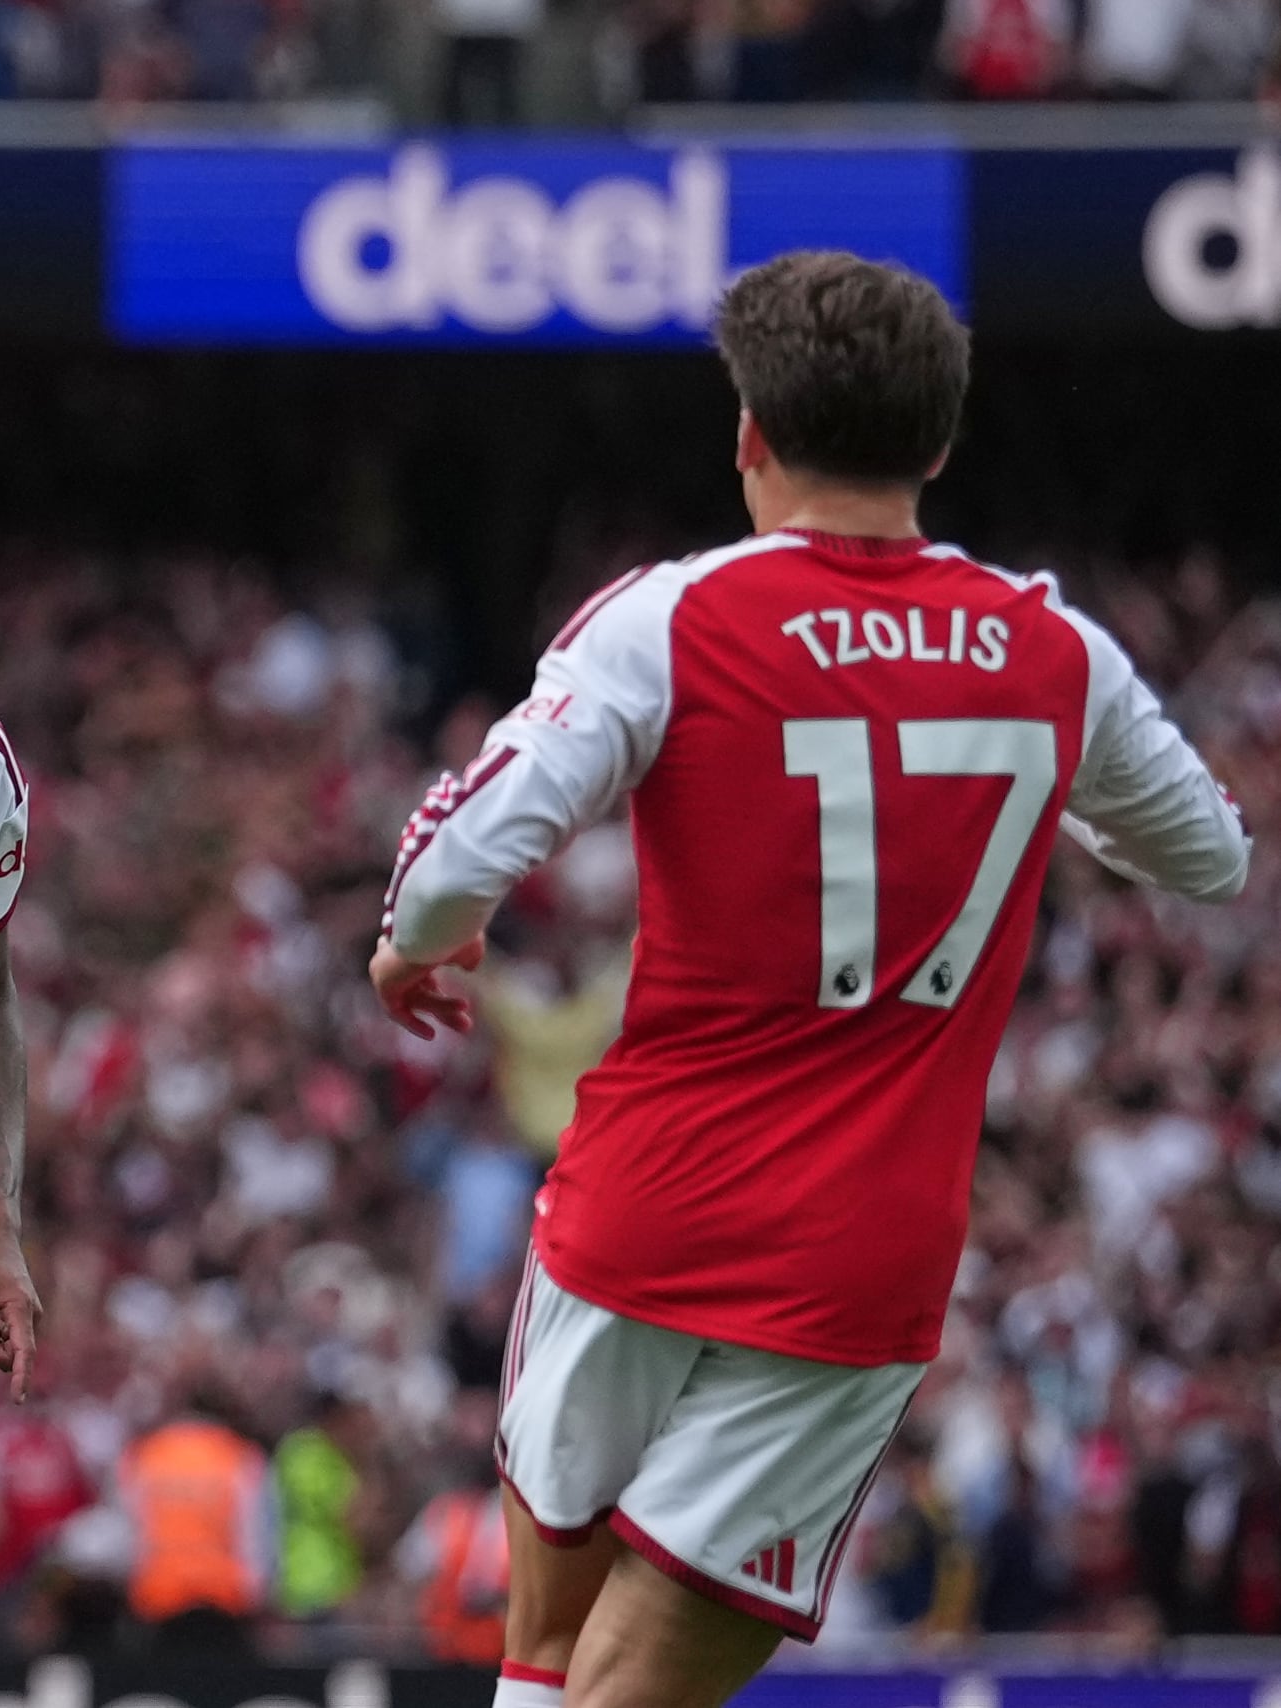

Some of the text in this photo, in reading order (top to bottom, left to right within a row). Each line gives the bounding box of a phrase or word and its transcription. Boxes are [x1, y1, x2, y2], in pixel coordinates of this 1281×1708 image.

[299, 143, 728, 332] deel
[781, 607, 1010, 672] TZOLIS
[782, 717, 1057, 1009] 17
